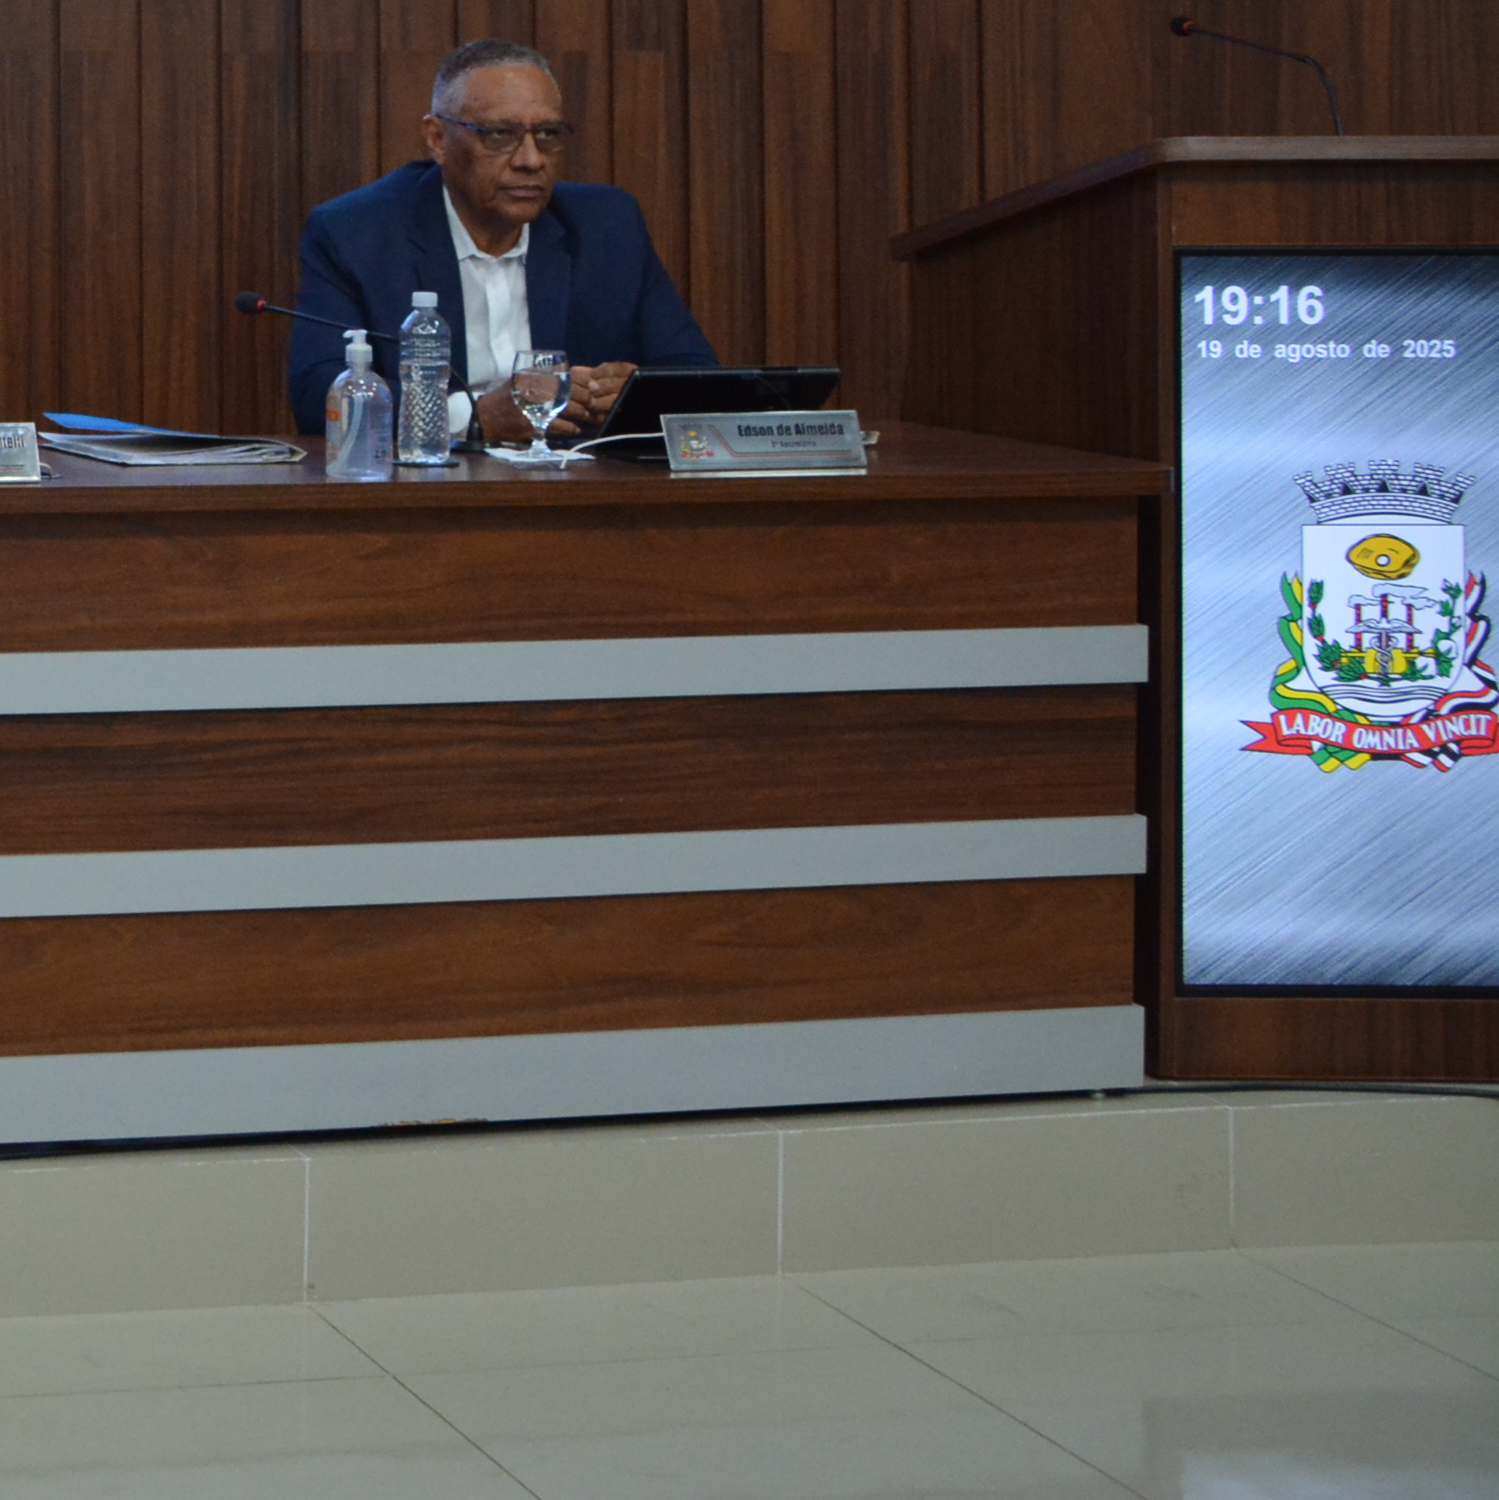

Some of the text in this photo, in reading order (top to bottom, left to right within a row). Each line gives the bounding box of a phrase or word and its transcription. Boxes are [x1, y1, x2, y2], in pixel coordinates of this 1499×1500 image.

[1194, 285, 1325, 326] 19:16
[1197, 339, 1456, 363] 19 de agosto de 2025
[737, 422, 845, 437] Edson de Almeida
[1278, 713, 1492, 750] LABOR OMNIA VINCIT
